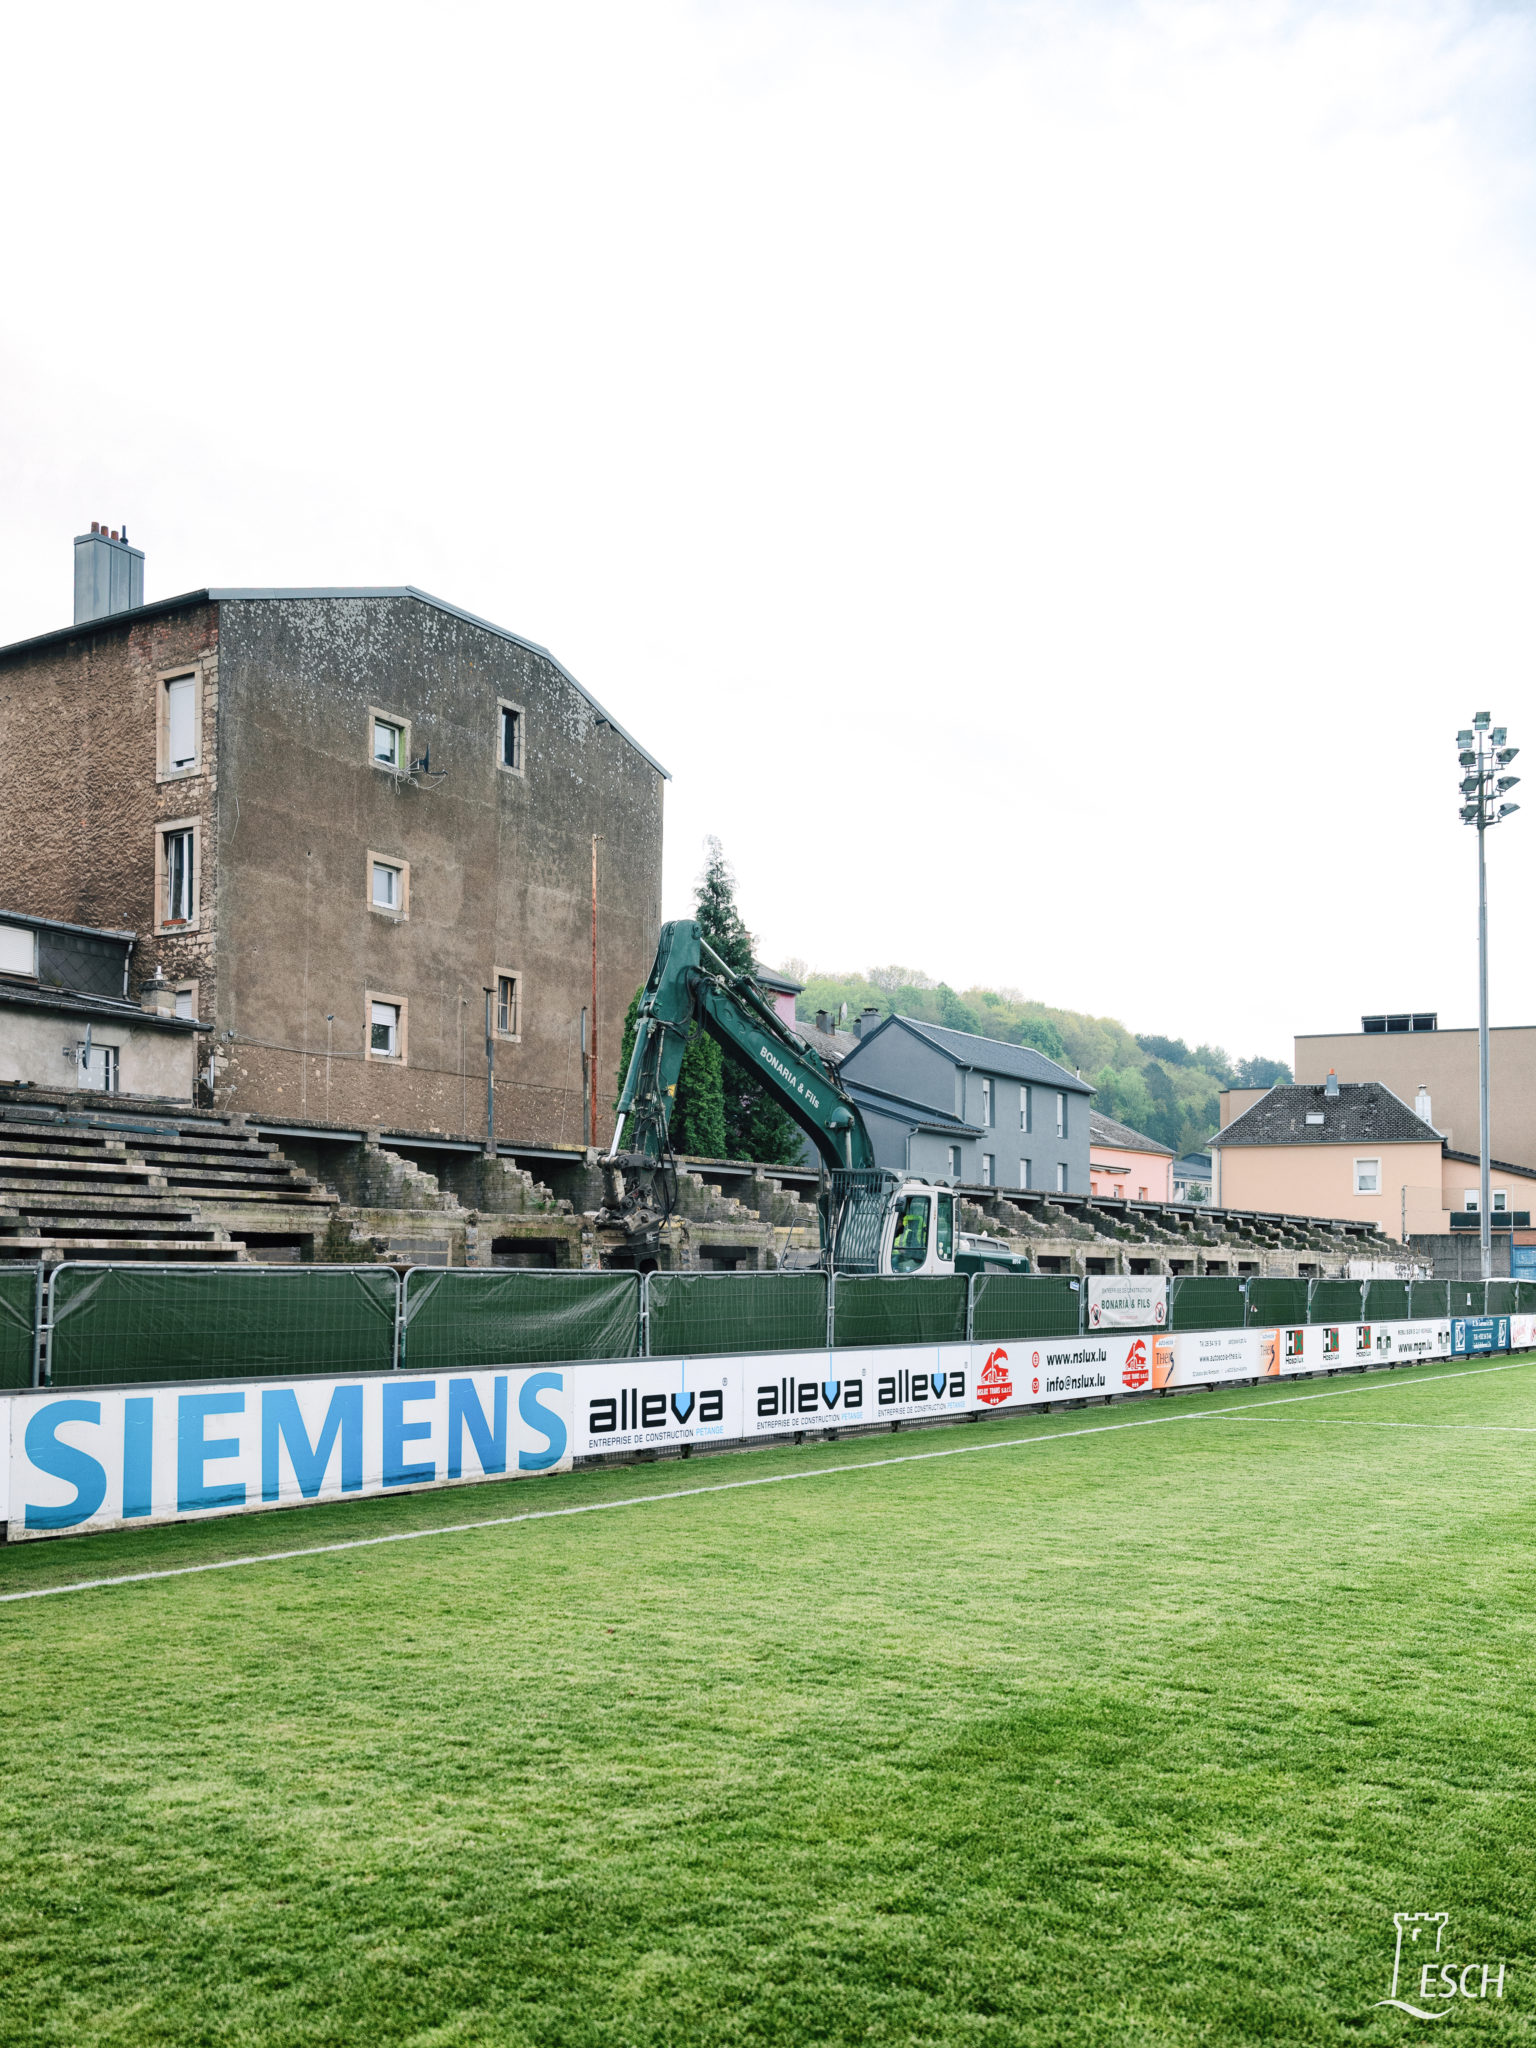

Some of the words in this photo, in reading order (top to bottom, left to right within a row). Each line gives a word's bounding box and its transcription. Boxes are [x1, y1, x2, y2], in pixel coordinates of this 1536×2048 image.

[760, 1046, 797, 1087] BONARIA
[797, 1083, 804, 1094] &
[805, 1089, 820, 1108] Fils
[1101, 1299, 1129, 1310] BONARIA
[1130, 1299, 1135, 1309] &
[1137, 1298, 1151, 1309] FILS
[1046, 1348, 1107, 1366] www.nslux.lu
[878, 1369, 965, 1405] alleva
[1046, 1372, 1106, 1392] info@nslux.lu
[757, 1377, 863, 1417] alleva
[589, 1388, 723, 1433] alleva
[757, 1419, 790, 1430] ENTREPRISE
[792, 1417, 799, 1426] DE
[801, 1414, 840, 1426] CONSTRUCTION
[841, 1411, 863, 1421] PETANGE
[878, 1407, 906, 1417] ENTREPRISE
[907, 1406, 913, 1414] DE
[914, 1403, 946, 1413] CONSTRUCTION
[589, 1435, 632, 1448] ENTREPRISE
[634, 1434, 644, 1443] DE
[645, 1429, 694, 1443] CONSTRUCTION
[696, 1425, 724, 1437] PETANGE
[25, 1372, 567, 1530] SIEMENS
